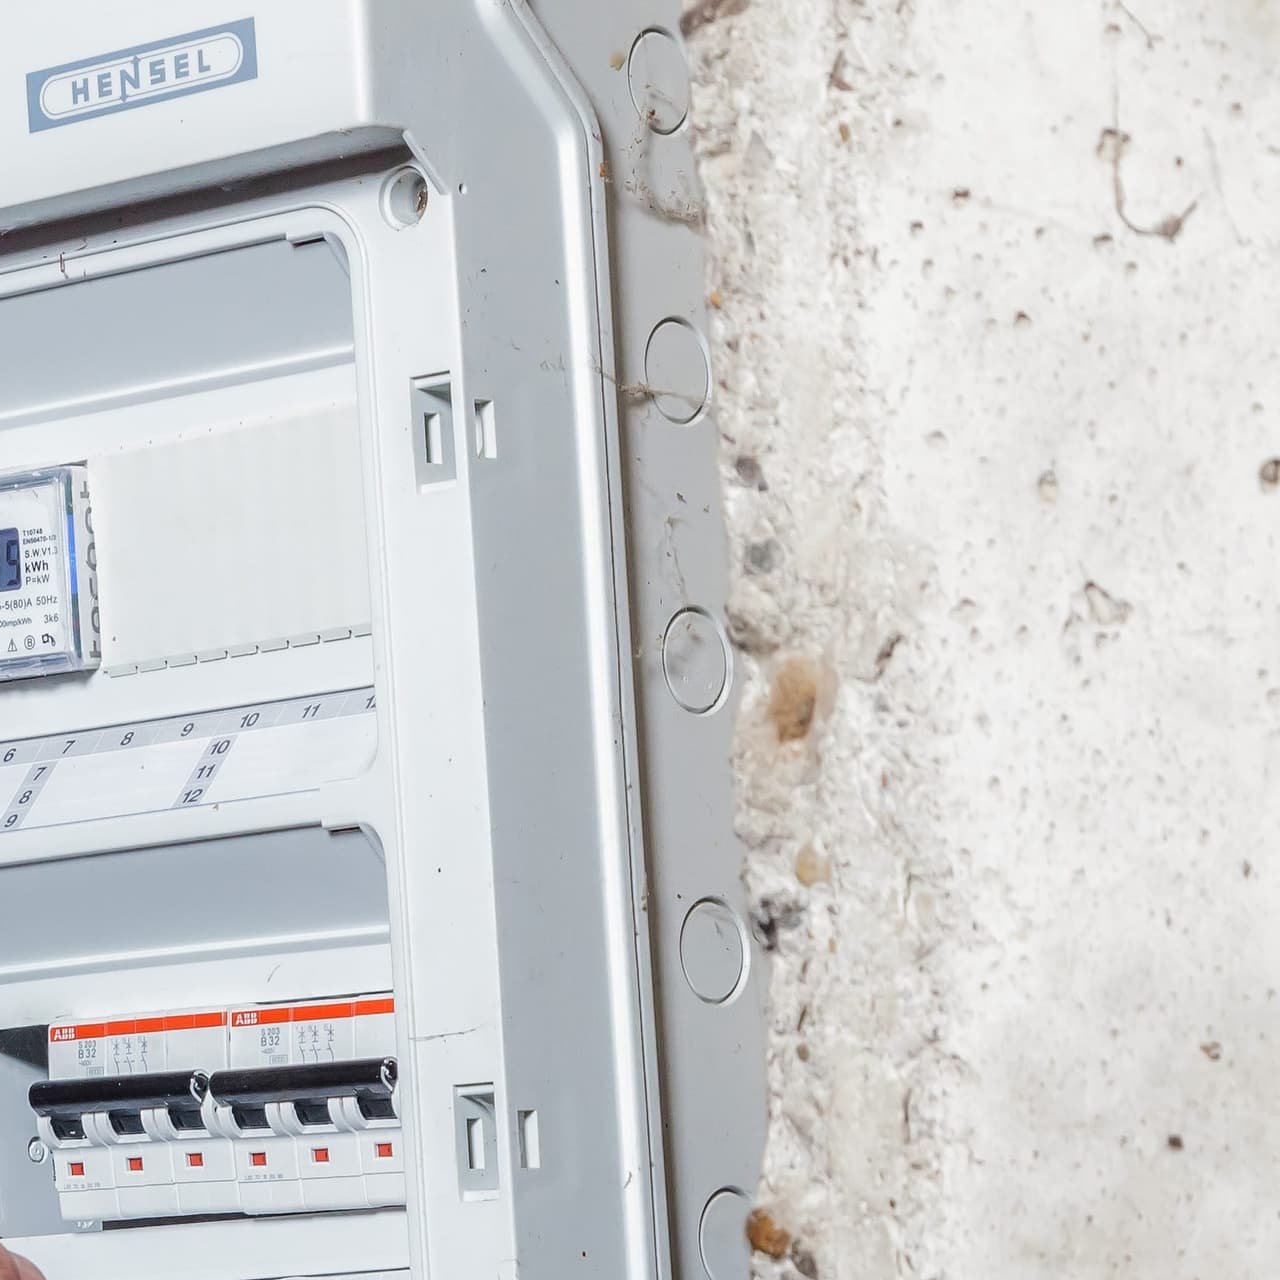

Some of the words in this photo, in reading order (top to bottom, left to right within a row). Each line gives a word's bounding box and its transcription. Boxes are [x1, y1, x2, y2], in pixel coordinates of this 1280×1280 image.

[71, 49, 211, 105] HENSEL
[25, 560, 49, 574] kWh
[36, 595, 58, 606] 50Hz
[44, 613, 59, 624] 3k6
[3, 748, 18, 763] 6
[62, 740, 77, 754] 7
[120, 731, 135, 746] 8
[180, 722, 195, 737] 9
[239, 712, 261, 728] 10
[301, 703, 322, 719] 11
[210, 740, 231, 755] 10
[33, 766, 47, 781] 7
[196, 764, 217, 780] 11
[18, 790, 33, 804] 8
[182, 788, 203, 804] 12
[4, 814, 18, 828] 9
[235, 1012, 258, 1025] ABB
[53, 1027, 75, 1040] ABB
[269, 1036, 280, 1046] 32
[85, 1048, 97, 1058] 32
